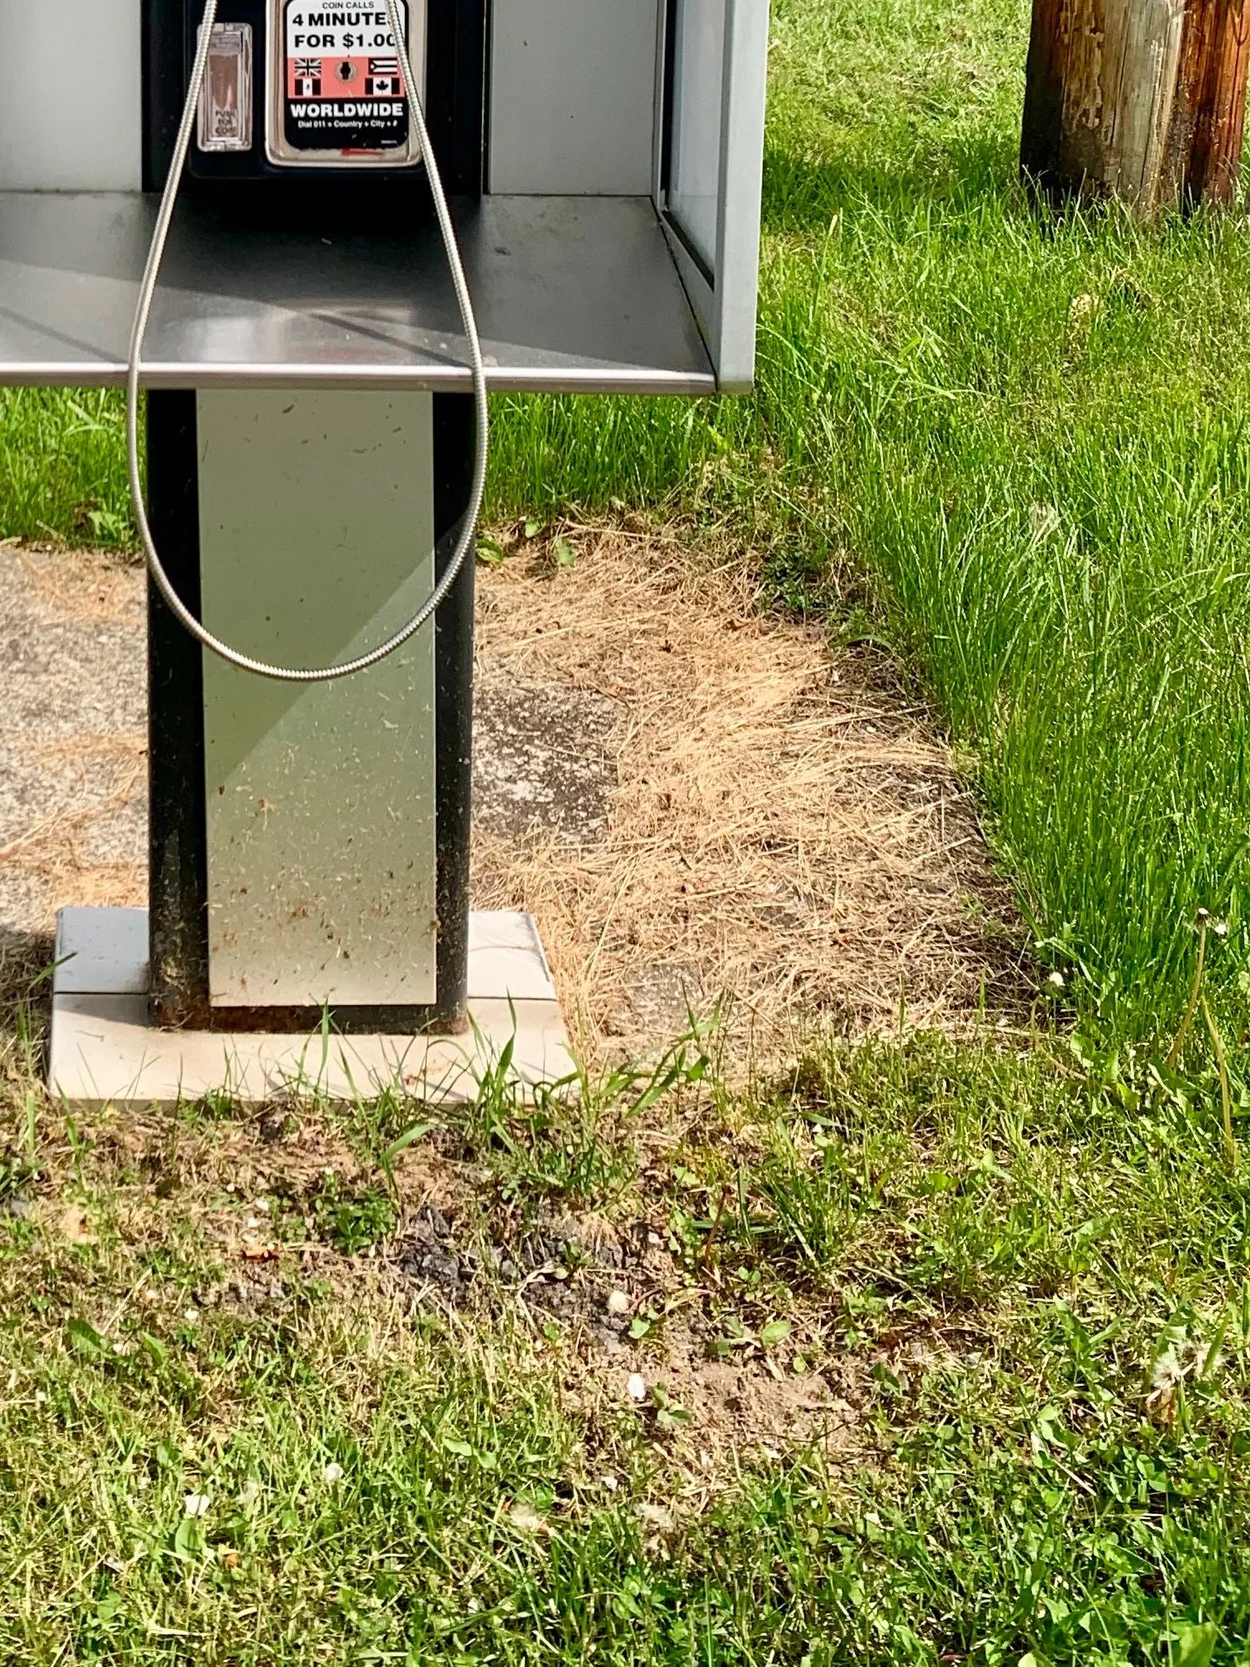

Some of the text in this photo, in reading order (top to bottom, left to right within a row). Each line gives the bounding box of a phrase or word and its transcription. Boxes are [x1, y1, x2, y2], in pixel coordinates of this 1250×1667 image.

[322, 1, 375, 9] COIN CALLS
[292, 12, 391, 27] 4 MINUTE
[294, 34, 336, 48] FOR
[290, 103, 404, 119] WORLDWIDE
[298, 120, 313, 129] Dial
[313, 120, 326, 128] 011
[333, 120, 363, 130] Country
[370, 119, 386, 128] City
